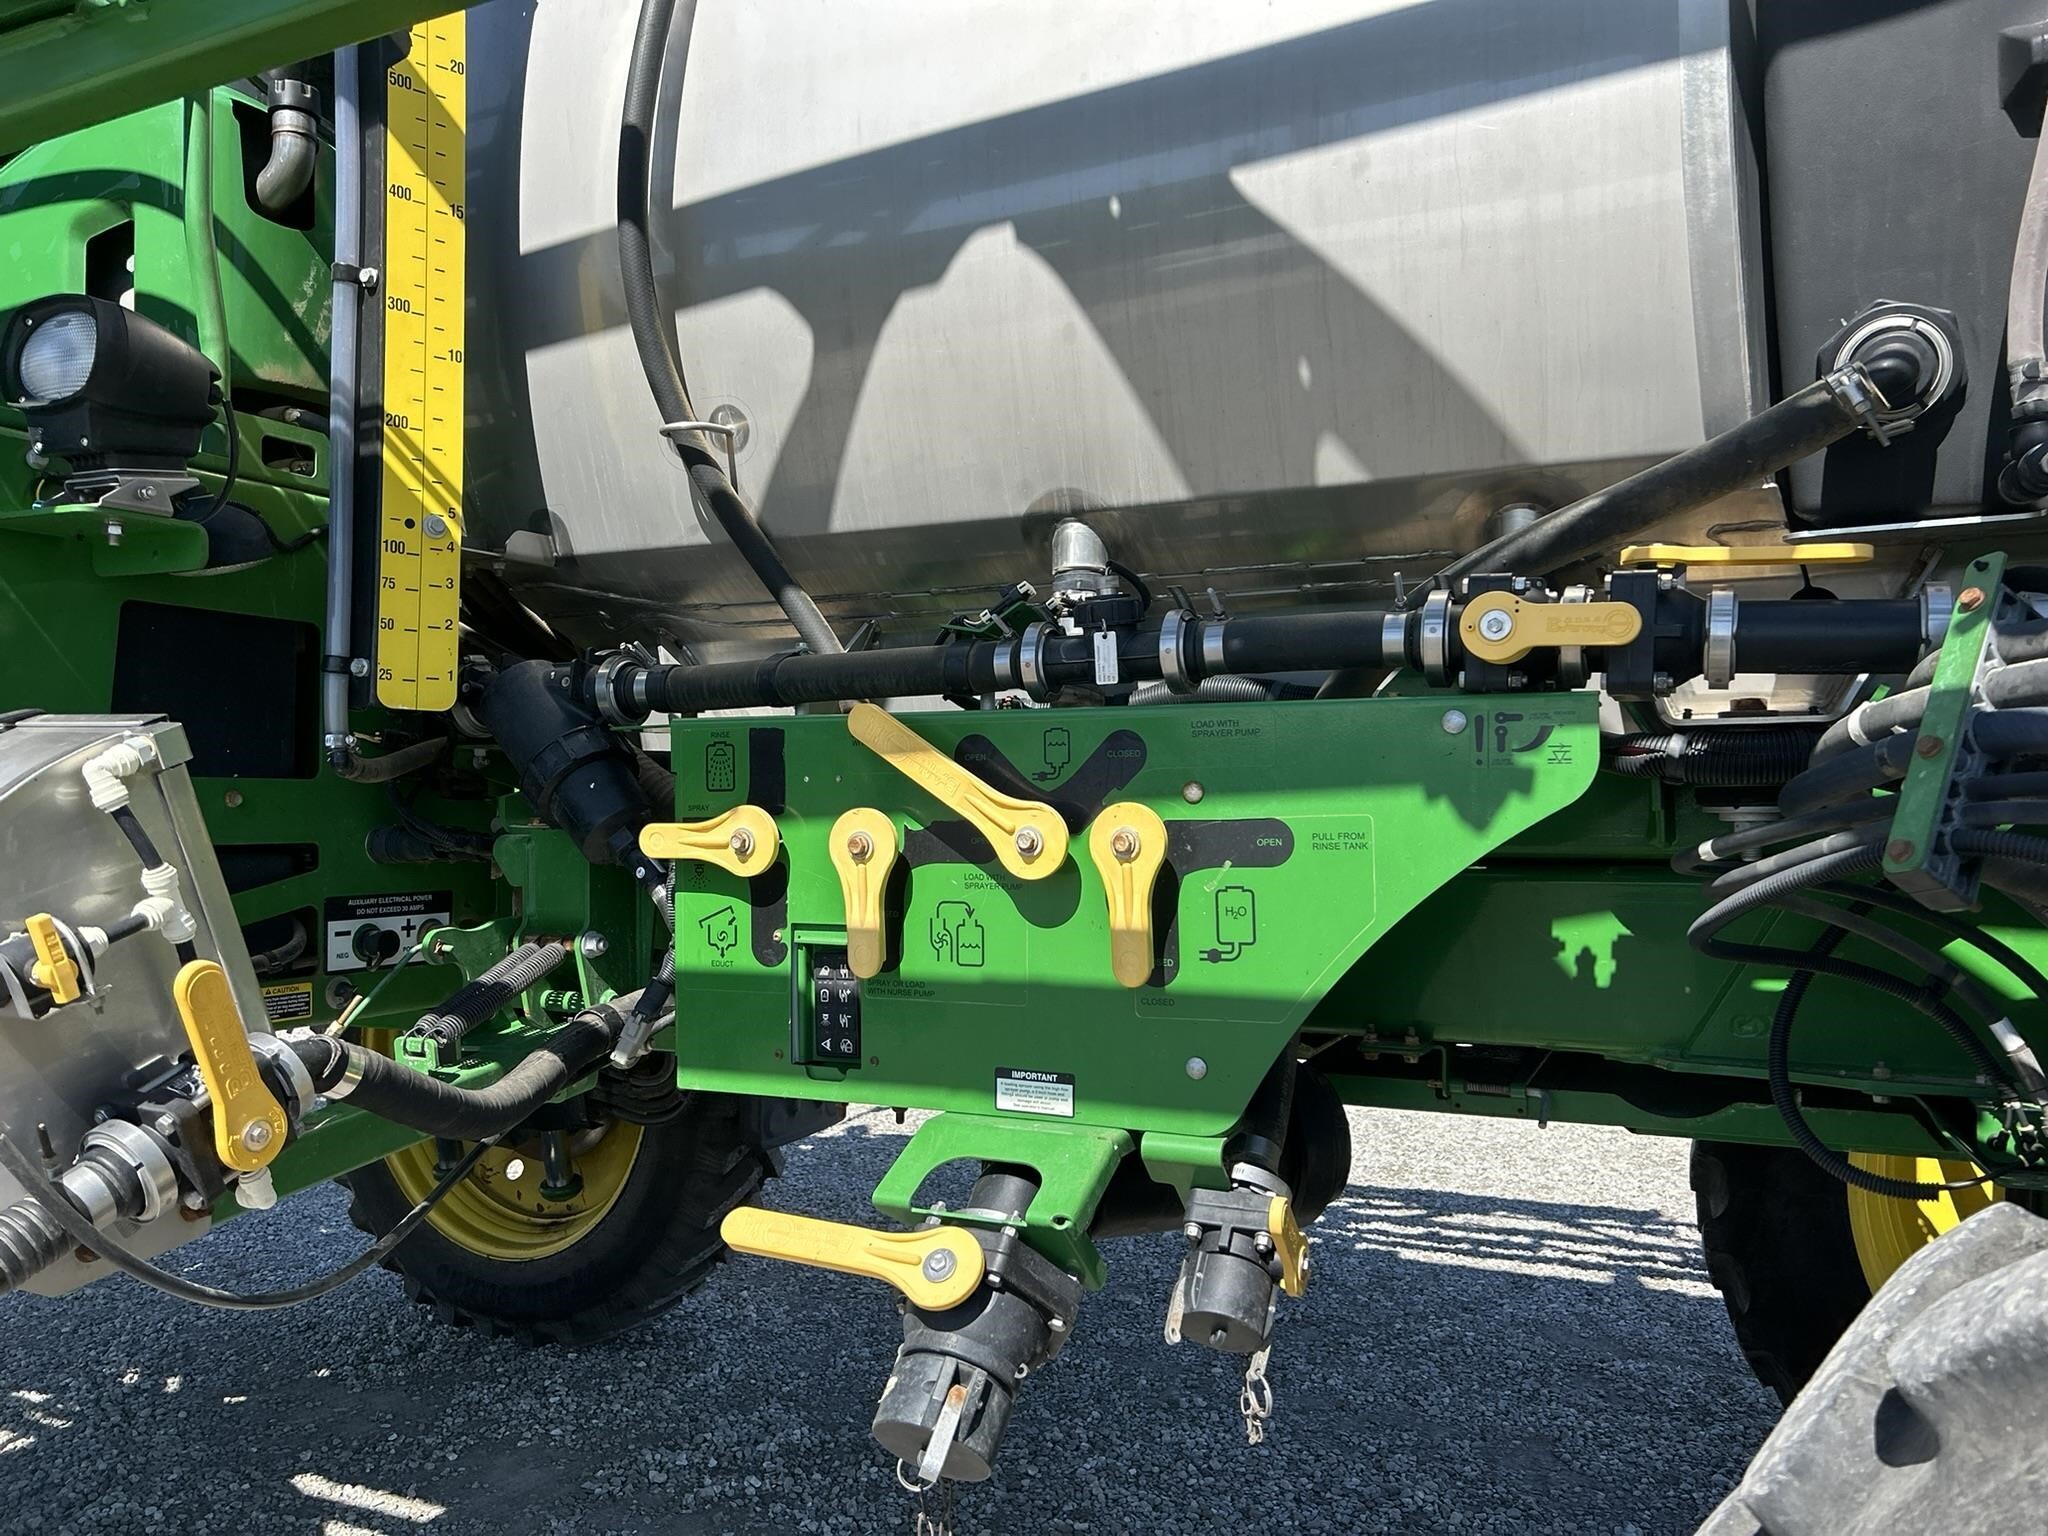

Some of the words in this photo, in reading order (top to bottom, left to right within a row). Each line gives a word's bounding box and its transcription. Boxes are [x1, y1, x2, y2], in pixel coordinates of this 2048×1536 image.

[450, 59, 464, 75] 20
[389, 72, 412, 91] 500
[389, 184, 412, 201] 400
[449, 204, 464, 220] 15
[387, 296, 410, 314] 300
[448, 350, 462, 364] 10
[385, 413, 408, 430] 200
[448, 507, 456, 519] 5
[383, 540, 405, 555] 100
[446, 541, 455, 553] 4
[382, 577, 396, 590] 75
[446, 578, 454, 590] 3
[380, 618, 395, 631] 50
[445, 619, 453, 631] 2
[379, 669, 392, 682] 25
[447, 670, 454, 682] 1
[1191, 720, 1215, 729] LOAD
[1217, 719, 1240, 728] WITH
[1191, 729, 1233, 738] SPRAYER
[1235, 727, 1261, 737] PUMP
[964, 753, 987, 761] OPEN
[1107, 749, 1142, 758] CLOSED
[687, 804, 710, 812] SPRAY
[1311, 832, 1335, 841] PULL
[1337, 831, 1366, 841] FROM
[1256, 838, 1283, 847] OPEN
[1312, 842, 1340, 851] RINSE
[1343, 841, 1369, 850] TANK
[963, 873, 985, 881] LOAD
[964, 882, 1000, 890] SPRAYER
[348, 898, 377, 906] AUXILIARY
[378, 895, 412, 904] ELECTRICAL
[413, 894, 433, 902] POWER
[379, 905, 401, 914] EXCEED
[272, 985, 300, 994] CAUTION
[887, 988, 912, 996] NURSE
[913, 989, 936, 997] PUMP
[1140, 998, 1175, 1007] CLOSED
[1011, 1070, 1058, 1082] IMPORTANT
